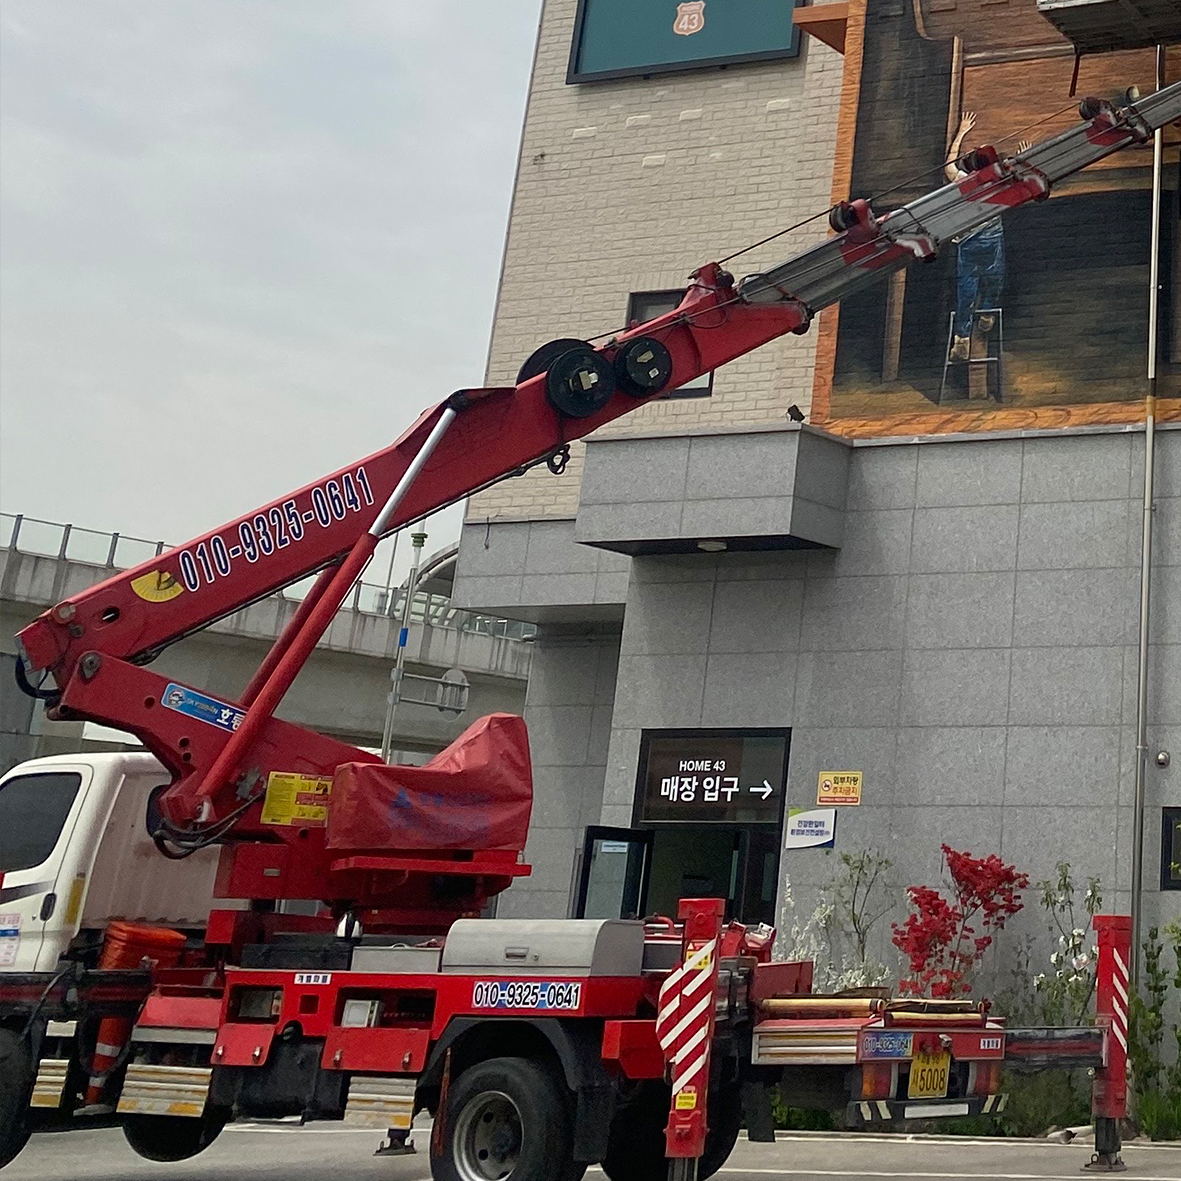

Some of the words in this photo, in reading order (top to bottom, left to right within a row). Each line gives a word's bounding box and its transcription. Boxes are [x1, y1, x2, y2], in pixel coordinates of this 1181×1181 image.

[678, 13, 700, 31] 43
[179, 466, 375, 594] 010-9325-0641
[679, 760, 711, 772] HOME
[713, 760, 726, 772] 43
[660, 775, 699, 802] 매장
[702, 775, 740, 802] 입구
[472, 982, 581, 1009] 010-9325-0641
